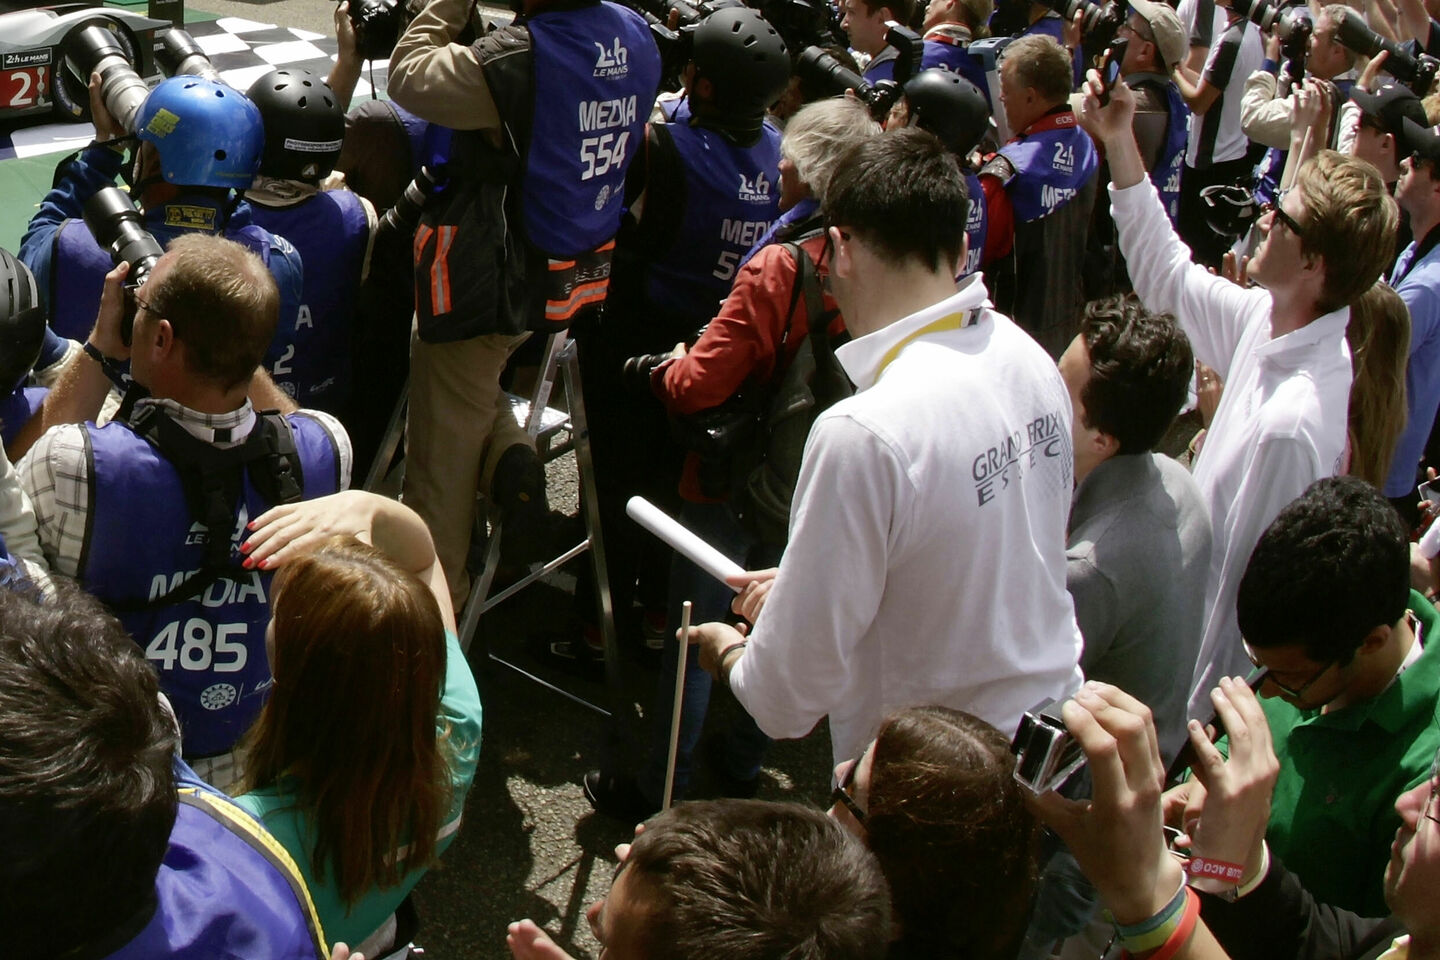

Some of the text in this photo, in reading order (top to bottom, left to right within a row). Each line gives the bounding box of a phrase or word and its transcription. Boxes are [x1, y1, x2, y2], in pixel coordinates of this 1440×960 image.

[28, 53, 49, 62] MANS
[595, 36, 628, 68] 24h
[592, 68, 606, 78] LE
[606, 64, 628, 76] MANS
[10, 72, 32, 106] 2
[579, 94, 637, 132] MEDIA
[1055, 116, 1073, 124] EOS
[580, 132, 630, 182] 554
[1053, 142, 1074, 168] 24h
[738, 172, 770, 196] 24h
[720, 218, 772, 247] MEDI
[146, 617, 248, 672] 485
